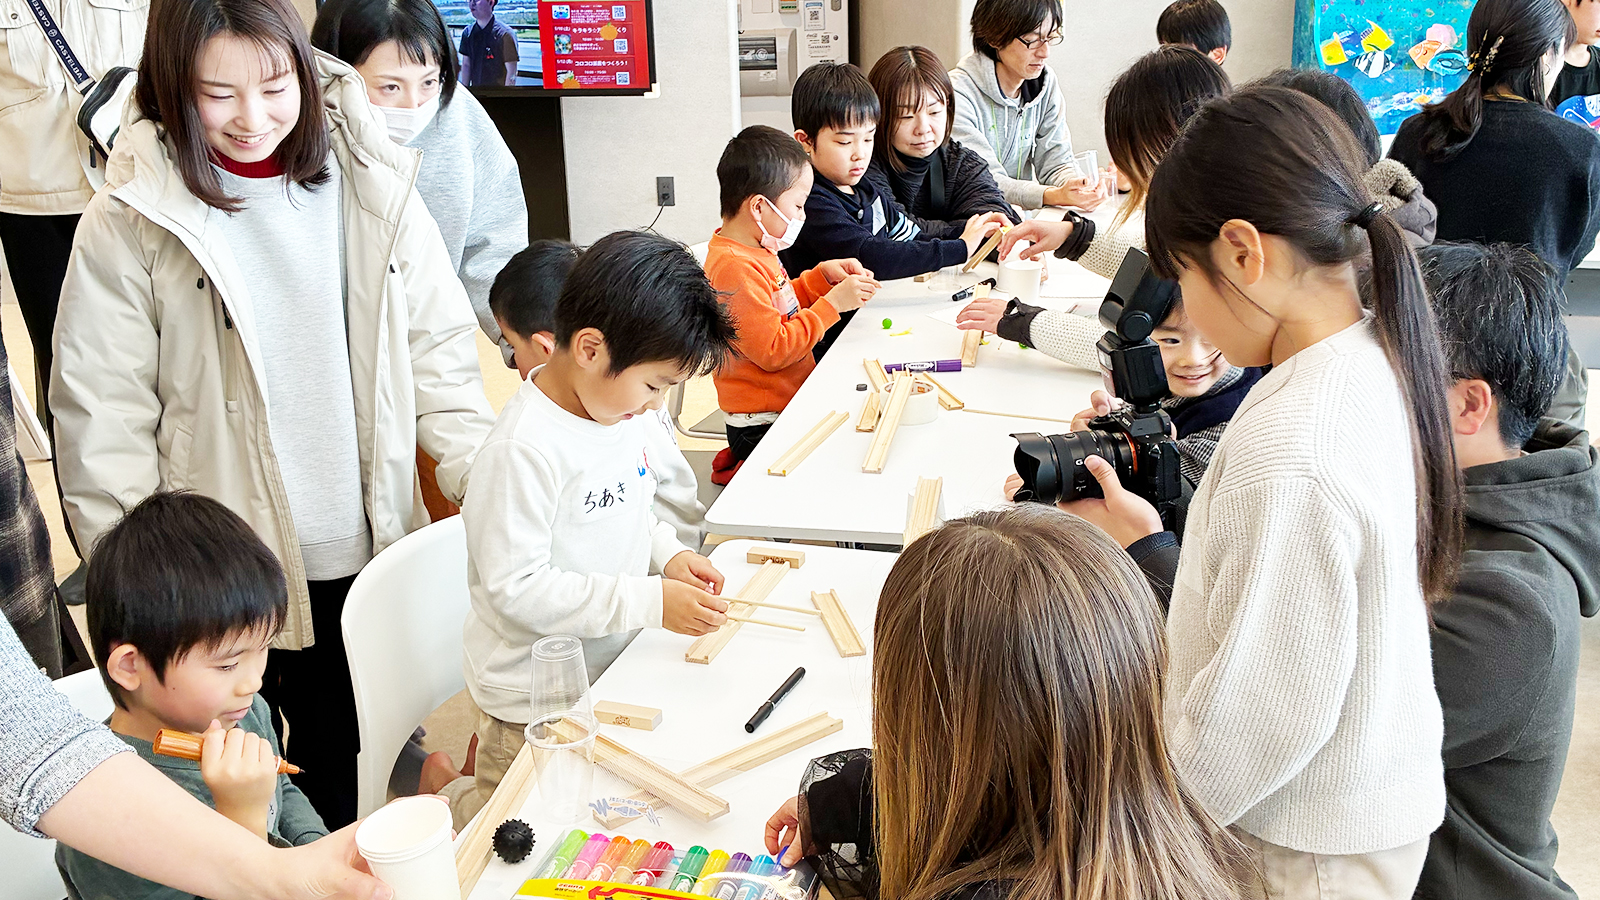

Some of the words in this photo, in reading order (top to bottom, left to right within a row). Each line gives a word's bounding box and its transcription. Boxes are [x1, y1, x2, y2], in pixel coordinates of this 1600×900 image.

[32, 0, 50, 27] CASTE
[55, 39, 83, 80] CASTELBA
[584, 482, 625, 514] ちあき
